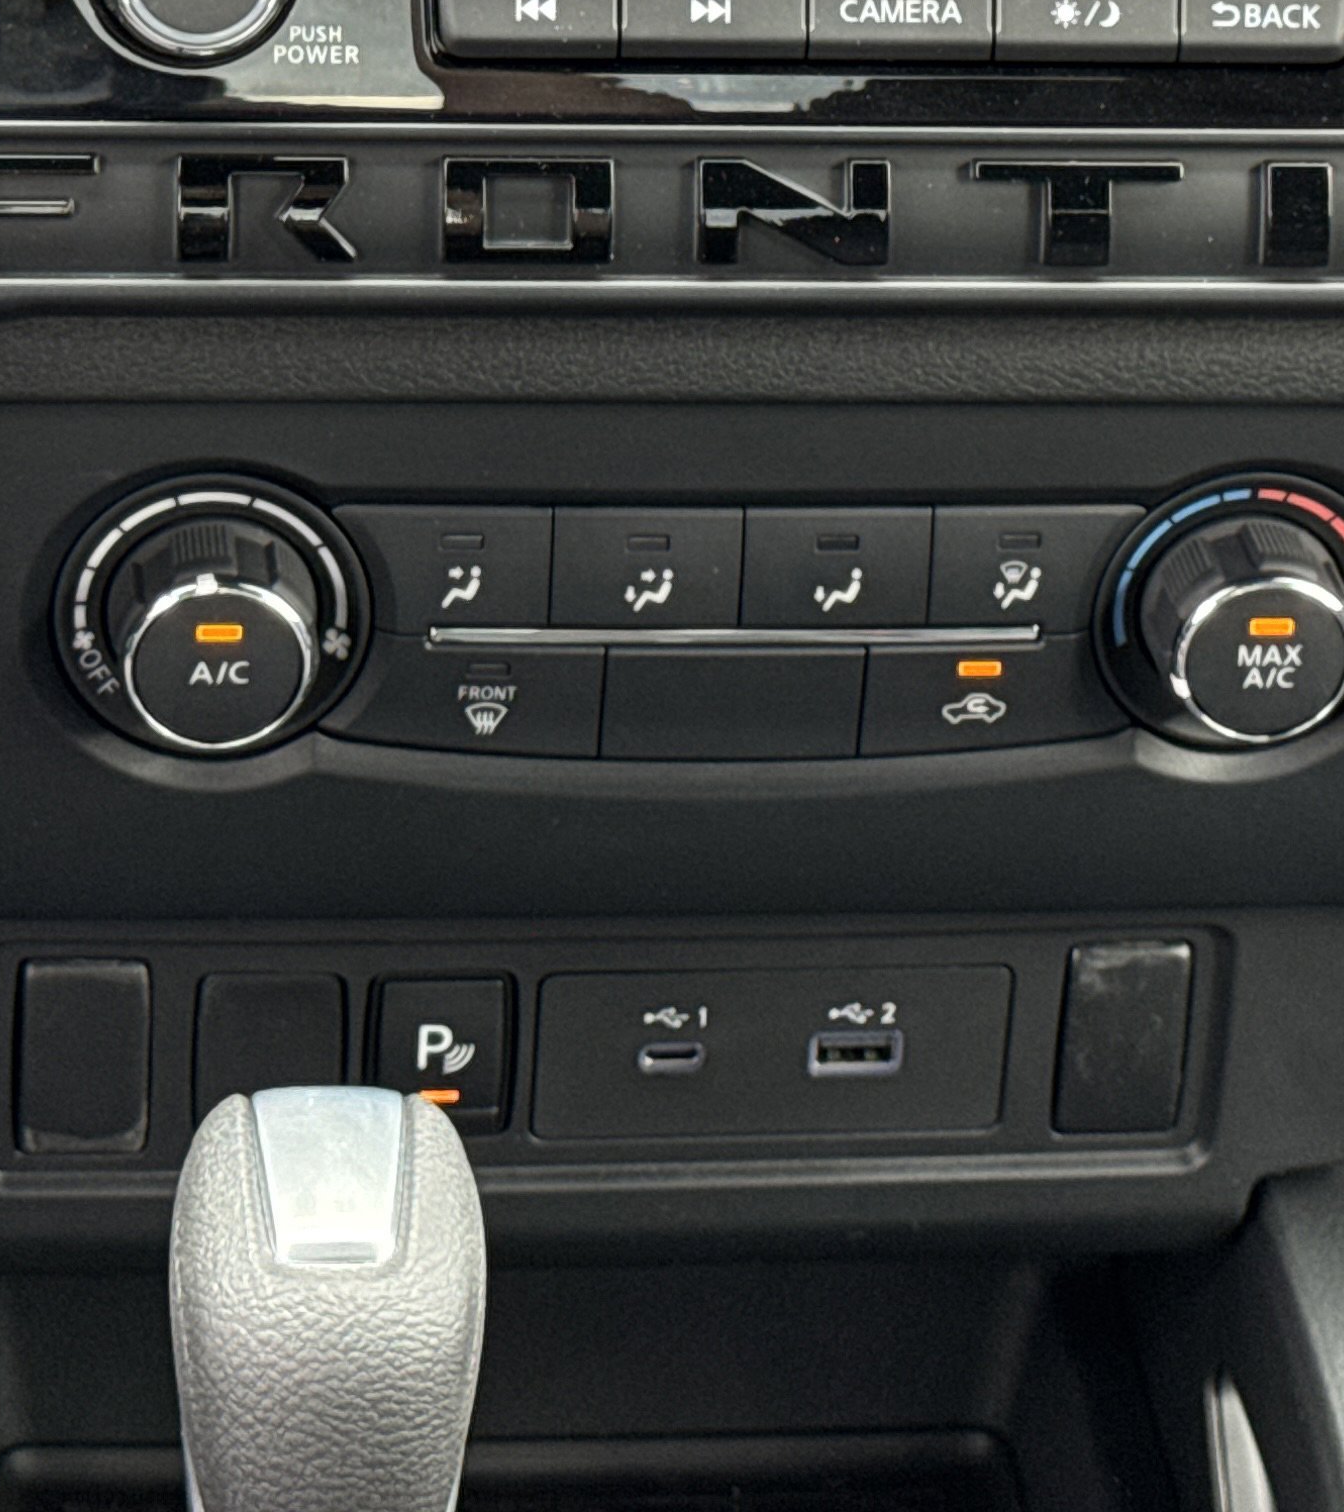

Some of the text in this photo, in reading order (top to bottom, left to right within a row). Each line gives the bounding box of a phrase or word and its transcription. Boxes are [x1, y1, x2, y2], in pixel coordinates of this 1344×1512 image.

[1244, 2, 1321, 30] BACK
[289, 25, 343, 43] PUSH
[273, 45, 360, 65] POWER
[1237, 644, 1303, 668] MAX
[78, 649, 120, 696] OFF
[188, 660, 250, 686] A/C
[1242, 667, 1295, 690] A/C
[457, 685, 517, 702] FRONT
[697, 1006, 708, 1027] 1
[881, 1002, 897, 1023] 2
[417, 1024, 453, 1070] P
